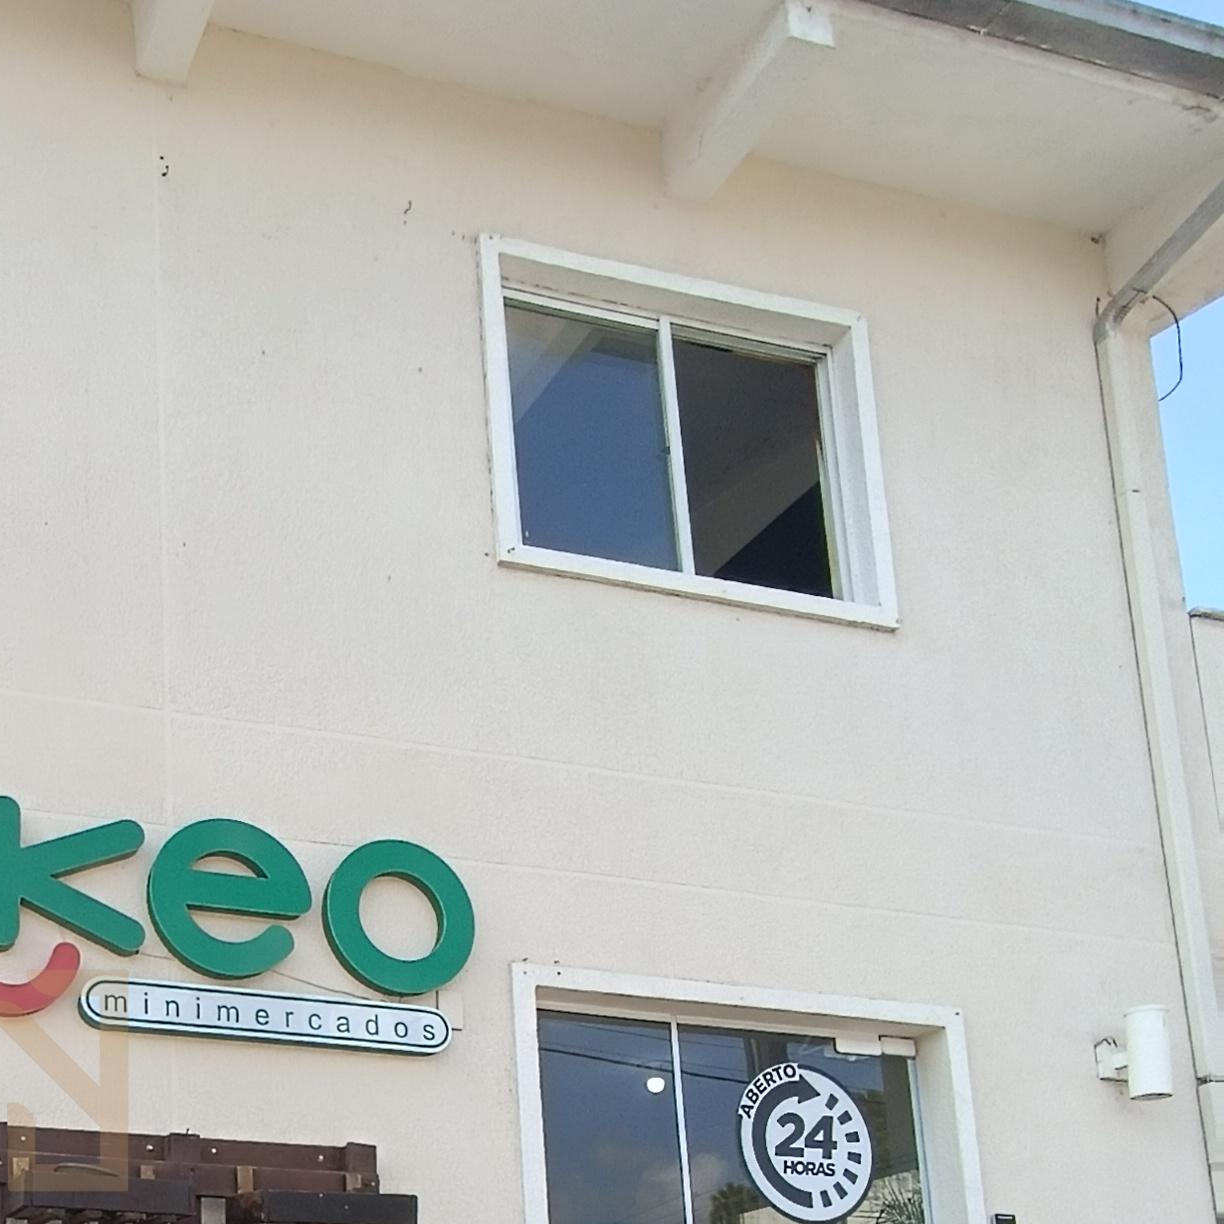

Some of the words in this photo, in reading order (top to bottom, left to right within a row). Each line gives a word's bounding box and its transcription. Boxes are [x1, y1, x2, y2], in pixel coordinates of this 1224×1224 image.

[103, 991, 436, 1041] minimercados
[740, 1064, 796, 1119] ABERTO
[774, 1112, 838, 1160] 24
[783, 1160, 836, 1177] HORAS
